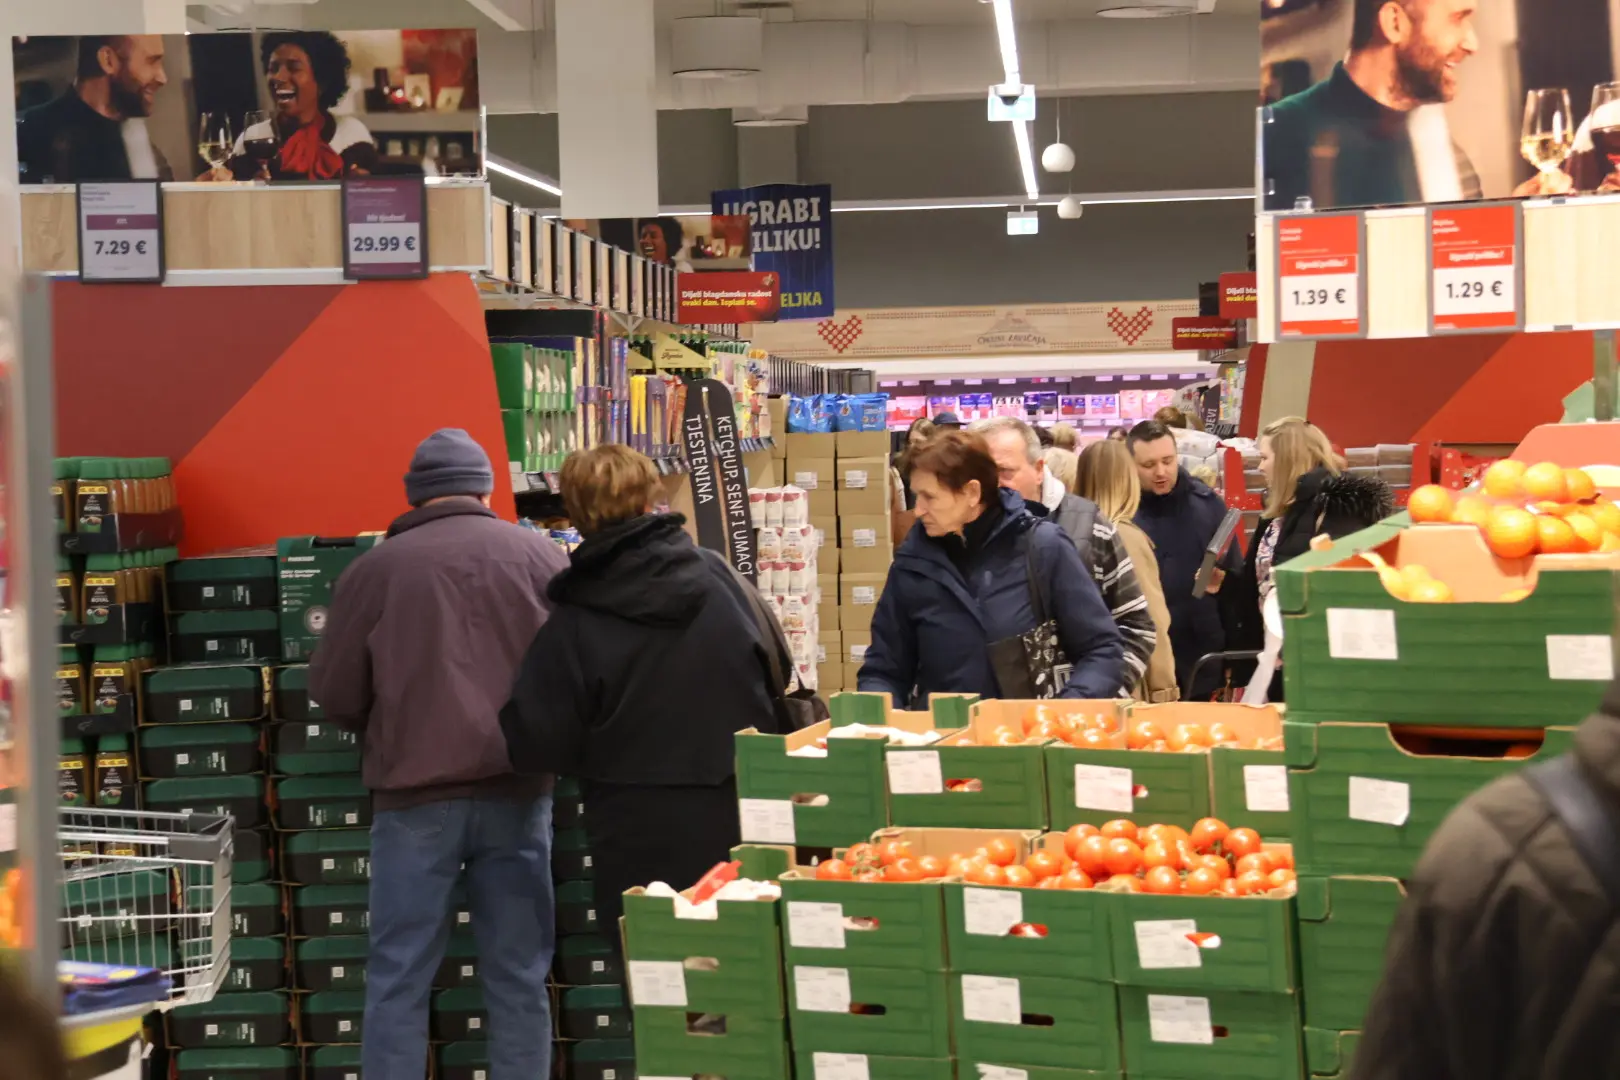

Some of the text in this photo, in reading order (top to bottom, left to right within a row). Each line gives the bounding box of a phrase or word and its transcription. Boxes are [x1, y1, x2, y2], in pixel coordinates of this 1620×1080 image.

[94, 240, 147, 255] 7.29 €
[353, 235, 416, 252] 29.99 €
[752, 228, 821, 253] ILIKU!
[1292, 288, 1346, 306] 1.39 €
[1446, 280, 1503, 299] 1.29 €
[1204, 408, 1218, 434] AJEVI
[686, 414, 714, 504] TJESTENINA
[716, 415, 739, 481] KETCHUP,
[726, 483, 745, 517] SENF
